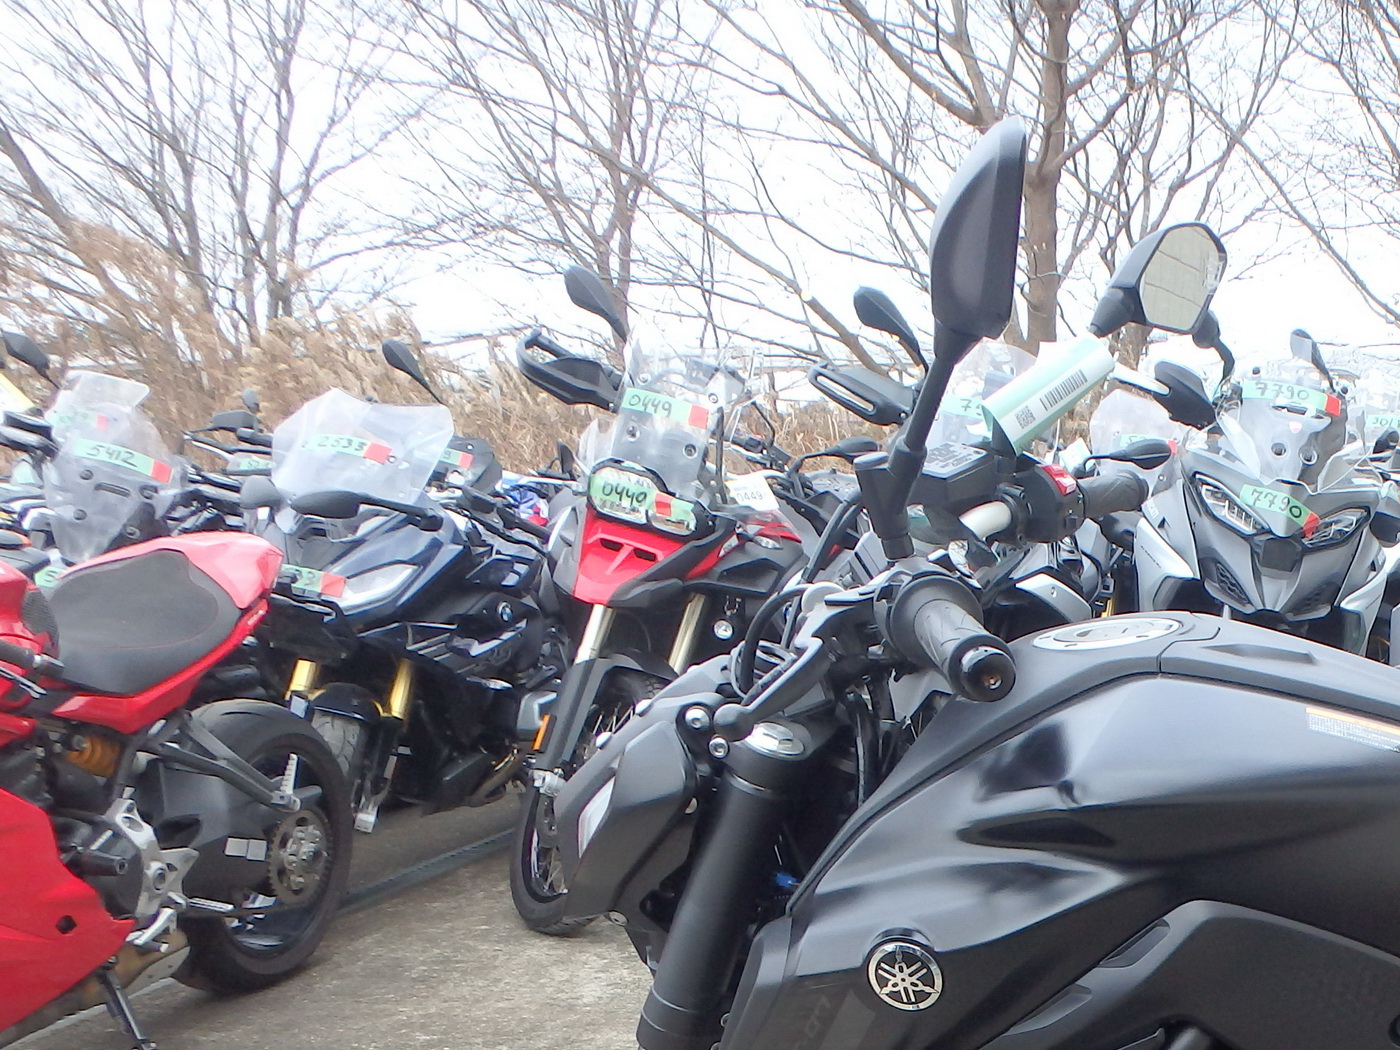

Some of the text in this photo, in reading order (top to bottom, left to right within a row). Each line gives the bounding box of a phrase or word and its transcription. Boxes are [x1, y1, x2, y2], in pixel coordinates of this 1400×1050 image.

[1254, 381, 1310, 401] 7790
[628, 393, 673, 419] 0449
[86, 444, 138, 468] 5412
[1251, 487, 1303, 519] 7790
